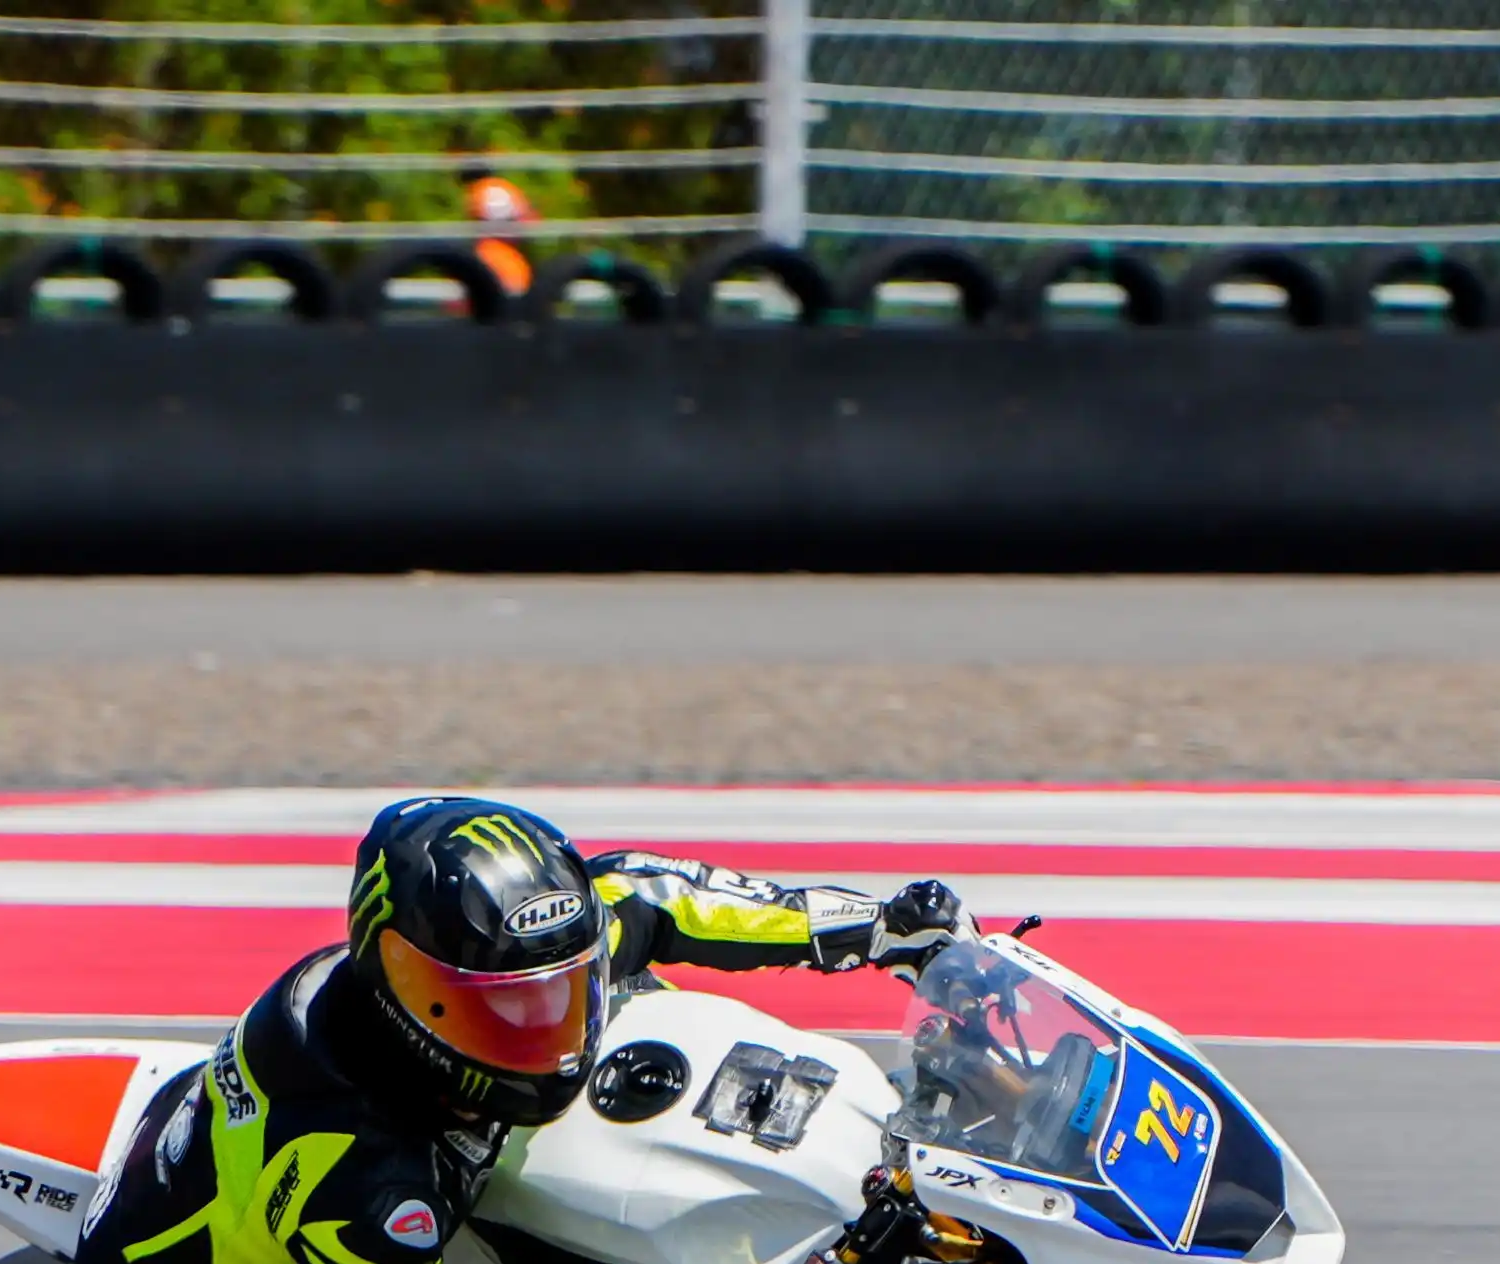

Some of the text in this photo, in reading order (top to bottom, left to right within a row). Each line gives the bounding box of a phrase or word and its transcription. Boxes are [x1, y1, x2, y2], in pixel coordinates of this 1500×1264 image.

[518, 897, 576, 930] HJC
[1133, 1077, 1195, 1164] 72
[924, 1165, 984, 1190] JPX
[36, 1183, 79, 1204] RIDE
